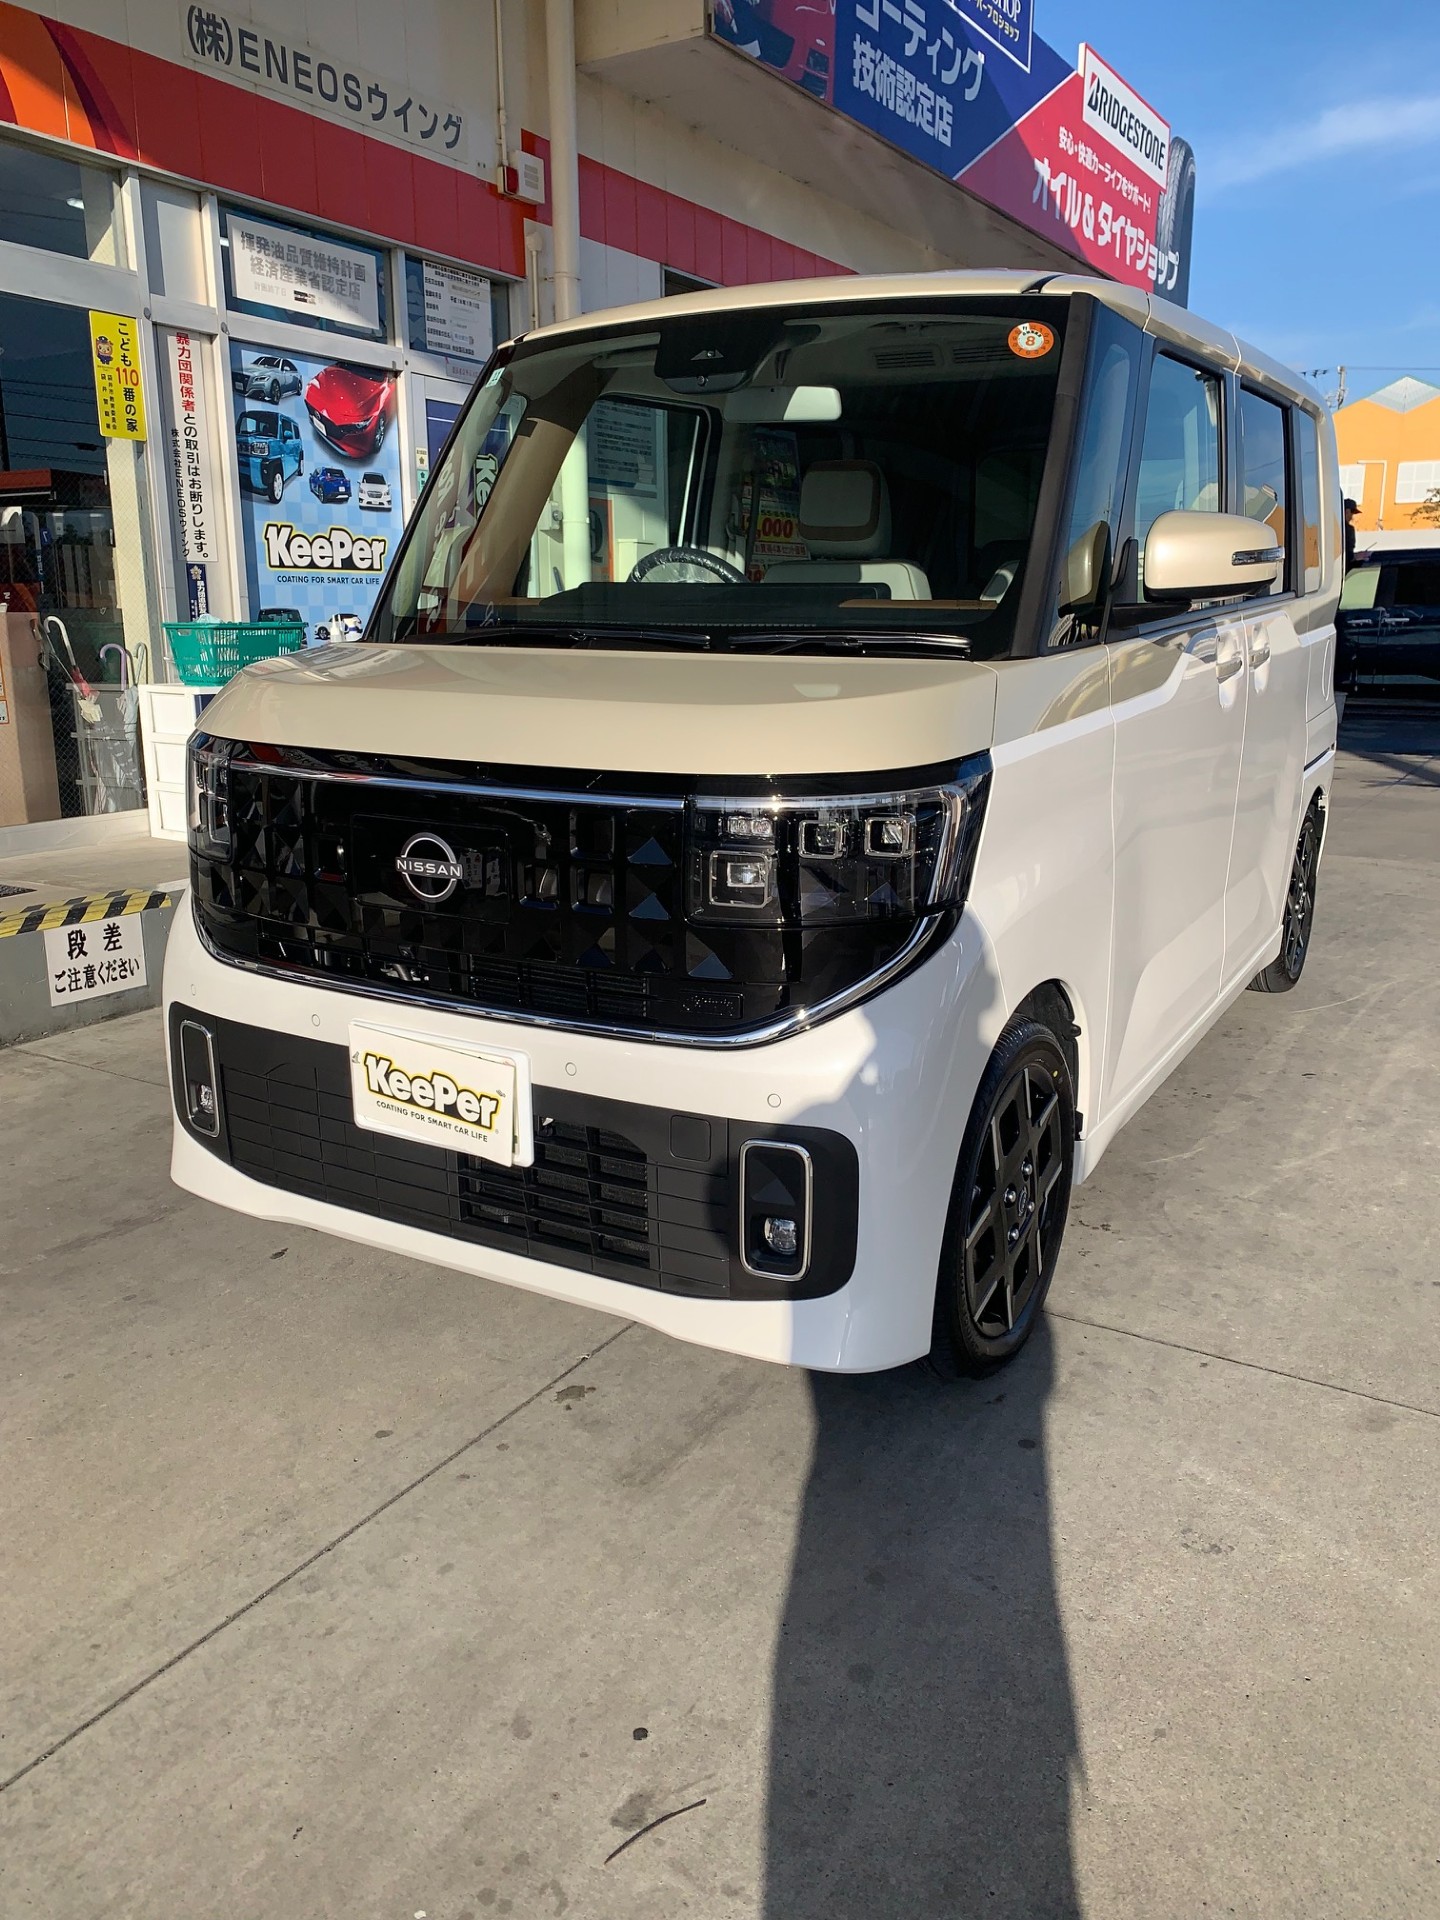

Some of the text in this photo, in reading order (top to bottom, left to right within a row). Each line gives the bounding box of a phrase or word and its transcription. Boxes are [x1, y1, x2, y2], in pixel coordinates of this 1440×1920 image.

[187, 5, 462, 149] (株)ENEOSウイング
[853, 33, 954, 147] 技術認定店
[1087, 72, 1166, 171] BRIDGESTONE
[241, 231, 366, 282] 揮発油品質維持計画
[250, 255, 361, 300] 経済産業省認定店
[116, 322, 140, 432] こども110番の家
[176, 332, 209, 559] 暴力団関係者との取引はお断りします。
[265, 523, 387, 572] KeePer
[276, 574, 380, 585] COATING FOR SMART CAR LIFE
[396, 859, 461, 877] NISSAN
[67, 922, 123, 960] 段差
[54, 958, 140, 993] ご注意ください
[364, 1052, 500, 1130] KeePer
[376, 1100, 488, 1143] COATING FOR SMART CAR LIFE
